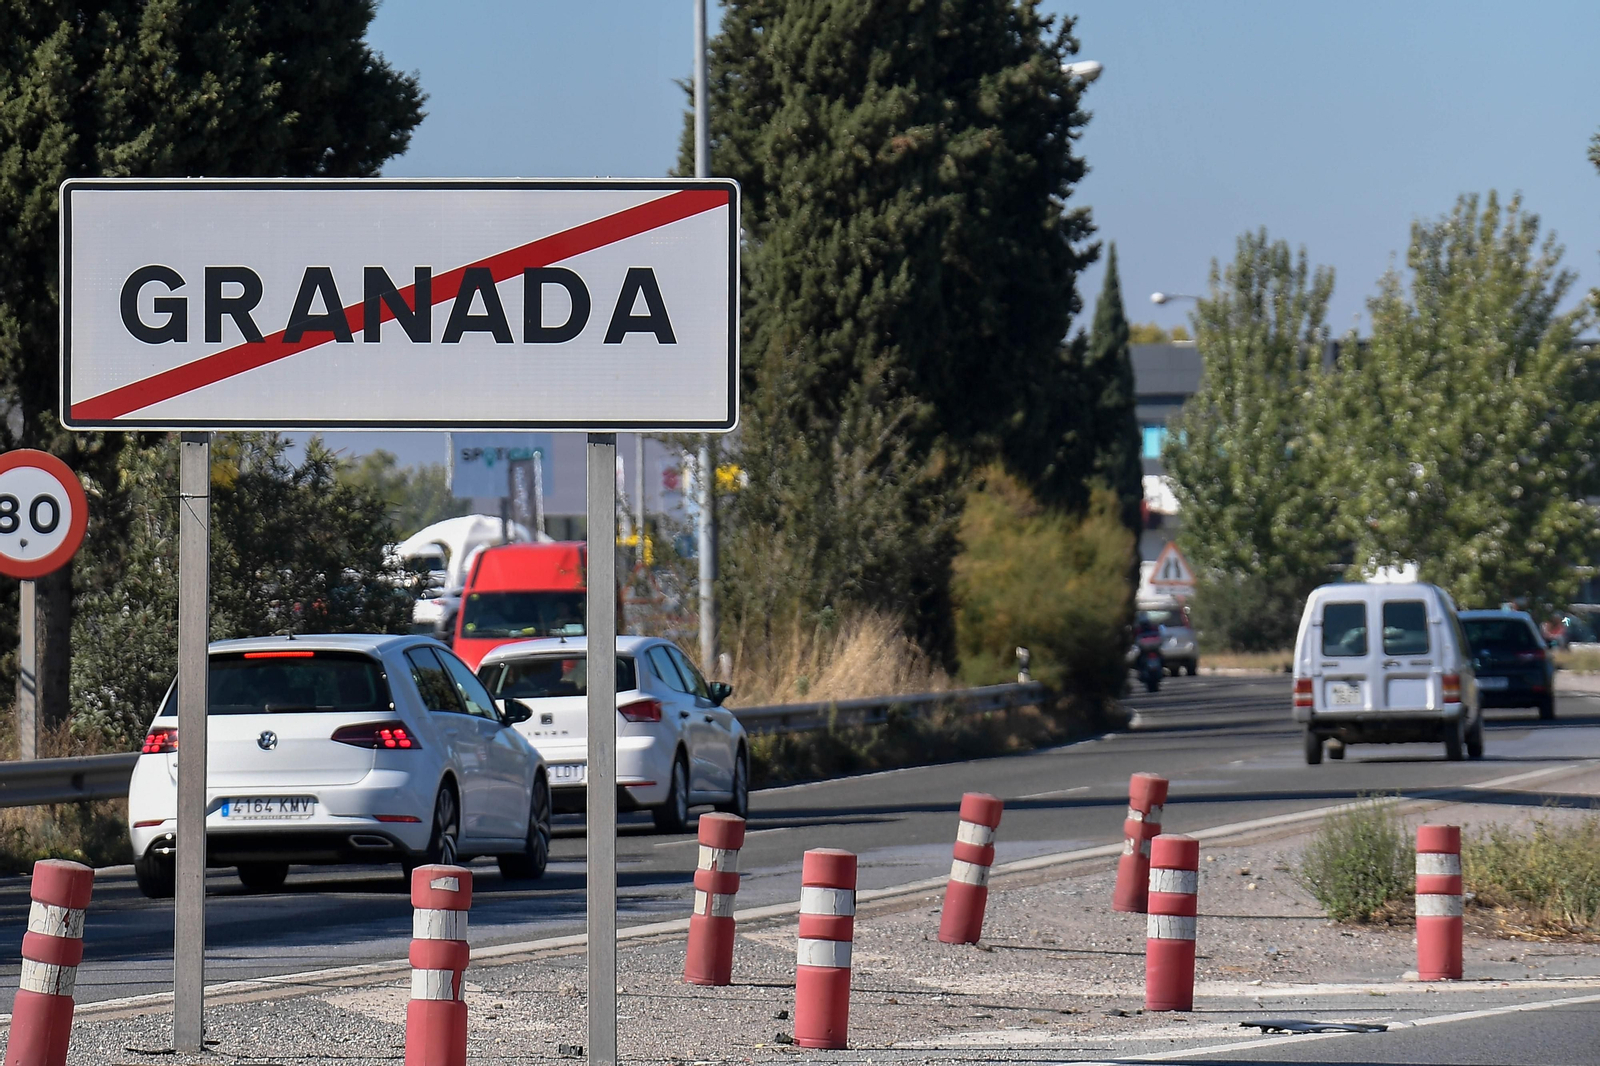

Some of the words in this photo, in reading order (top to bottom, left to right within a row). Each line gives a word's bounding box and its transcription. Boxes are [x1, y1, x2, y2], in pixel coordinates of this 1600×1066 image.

[119, 264, 677, 344] GRANADA
[0, 495, 60, 534] 80
[233, 798, 273, 813] 4164
[280, 797, 310, 812] KMV
